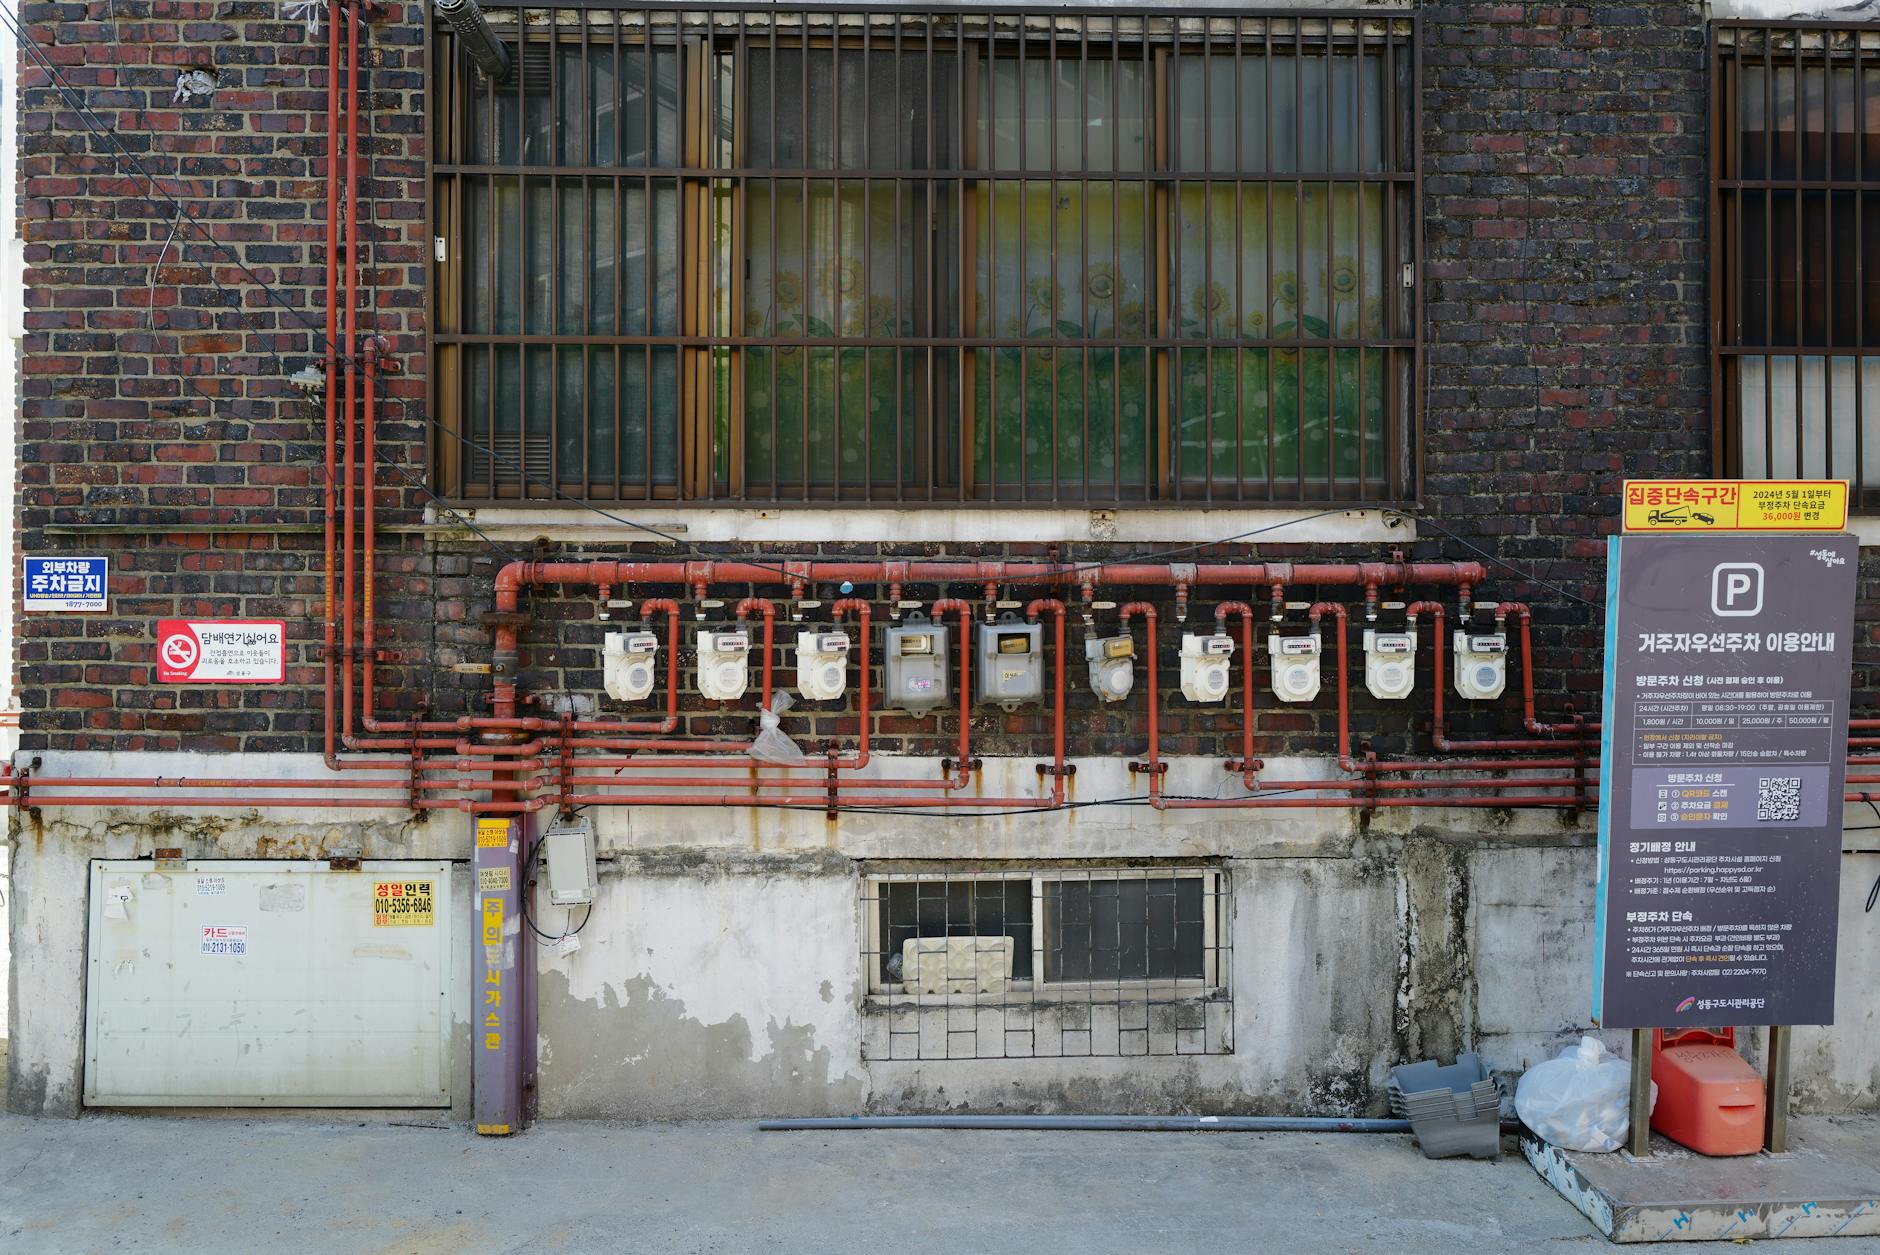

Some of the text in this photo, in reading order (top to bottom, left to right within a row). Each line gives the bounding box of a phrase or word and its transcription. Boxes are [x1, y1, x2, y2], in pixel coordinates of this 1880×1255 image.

[1628, 487, 1736, 506] 집중단속구간
[1753, 490, 1831, 499] 2024년 5월 1일부터
[1758, 501, 1825, 510] 부정주차 단속요금
[1762, 512, 1820, 521] 36,000원 변경
[42, 561, 90, 574] 외부차량
[32, 574, 100, 592] 주차금지
[1726, 574, 1751, 606] P
[1638, 632, 1835, 653] 거주자우선주차 이용안내
[1636, 675, 1680, 687] 방문주차
[1682, 675, 1704, 686] 신청
[1667, 773, 1722, 783] 방문주차 신청
[1681, 801, 1711, 809] 주차요금
[1629, 841, 1696, 853] 정기배정 안내
[377, 883, 430, 897] 성일인력
[376, 898, 431, 914] 010-5356-6846
[486, 901, 500, 942] 주의
[1626, 911, 1693, 922] 부정주차 단속
[203, 927, 229, 938] 카드
[203, 942, 245, 954] 010-2131-1050
[1697, 998, 1765, 1010] 성동구도시관리공단
